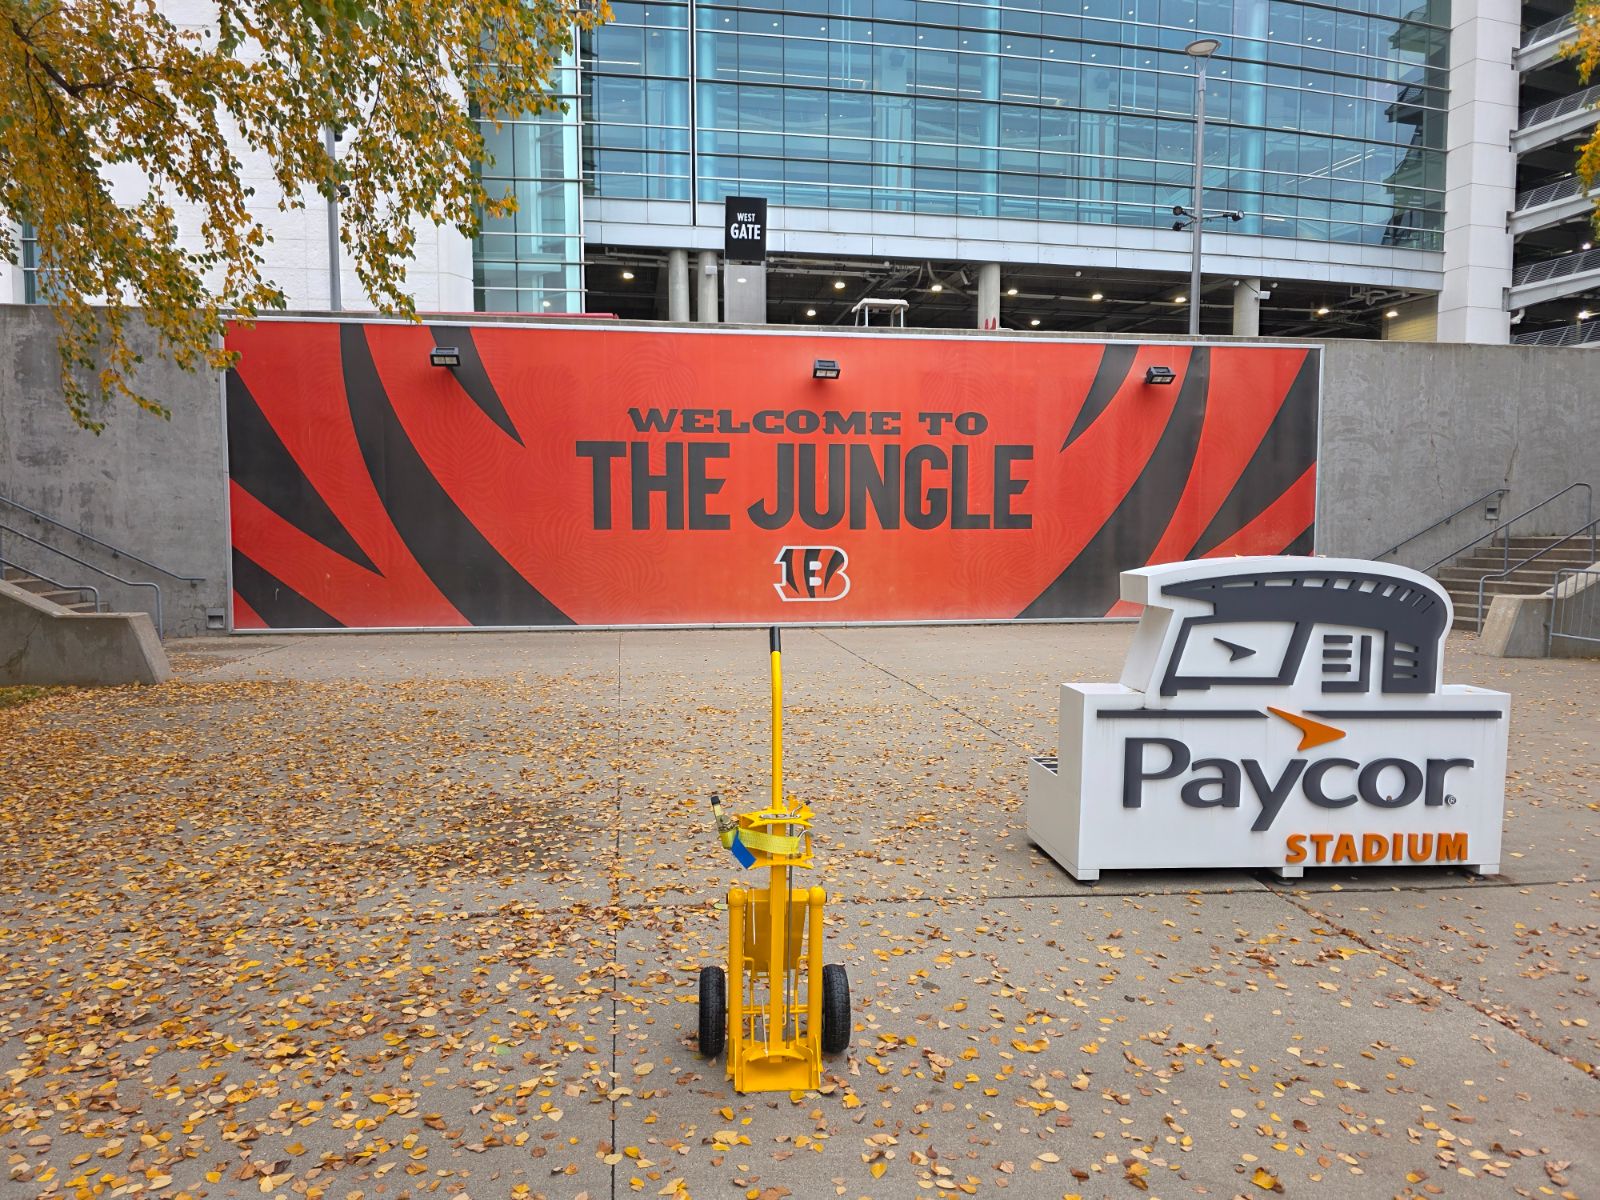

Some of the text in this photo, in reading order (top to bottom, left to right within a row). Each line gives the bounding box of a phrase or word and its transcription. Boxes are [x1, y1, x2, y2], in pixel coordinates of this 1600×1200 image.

[730, 223, 761, 240] GATE
[737, 212, 756, 222] WEST
[627, 407, 989, 436] WELCOME TO
[575, 440, 1034, 531] THE JUNGLE
[1285, 832, 1469, 863] STADIUM
